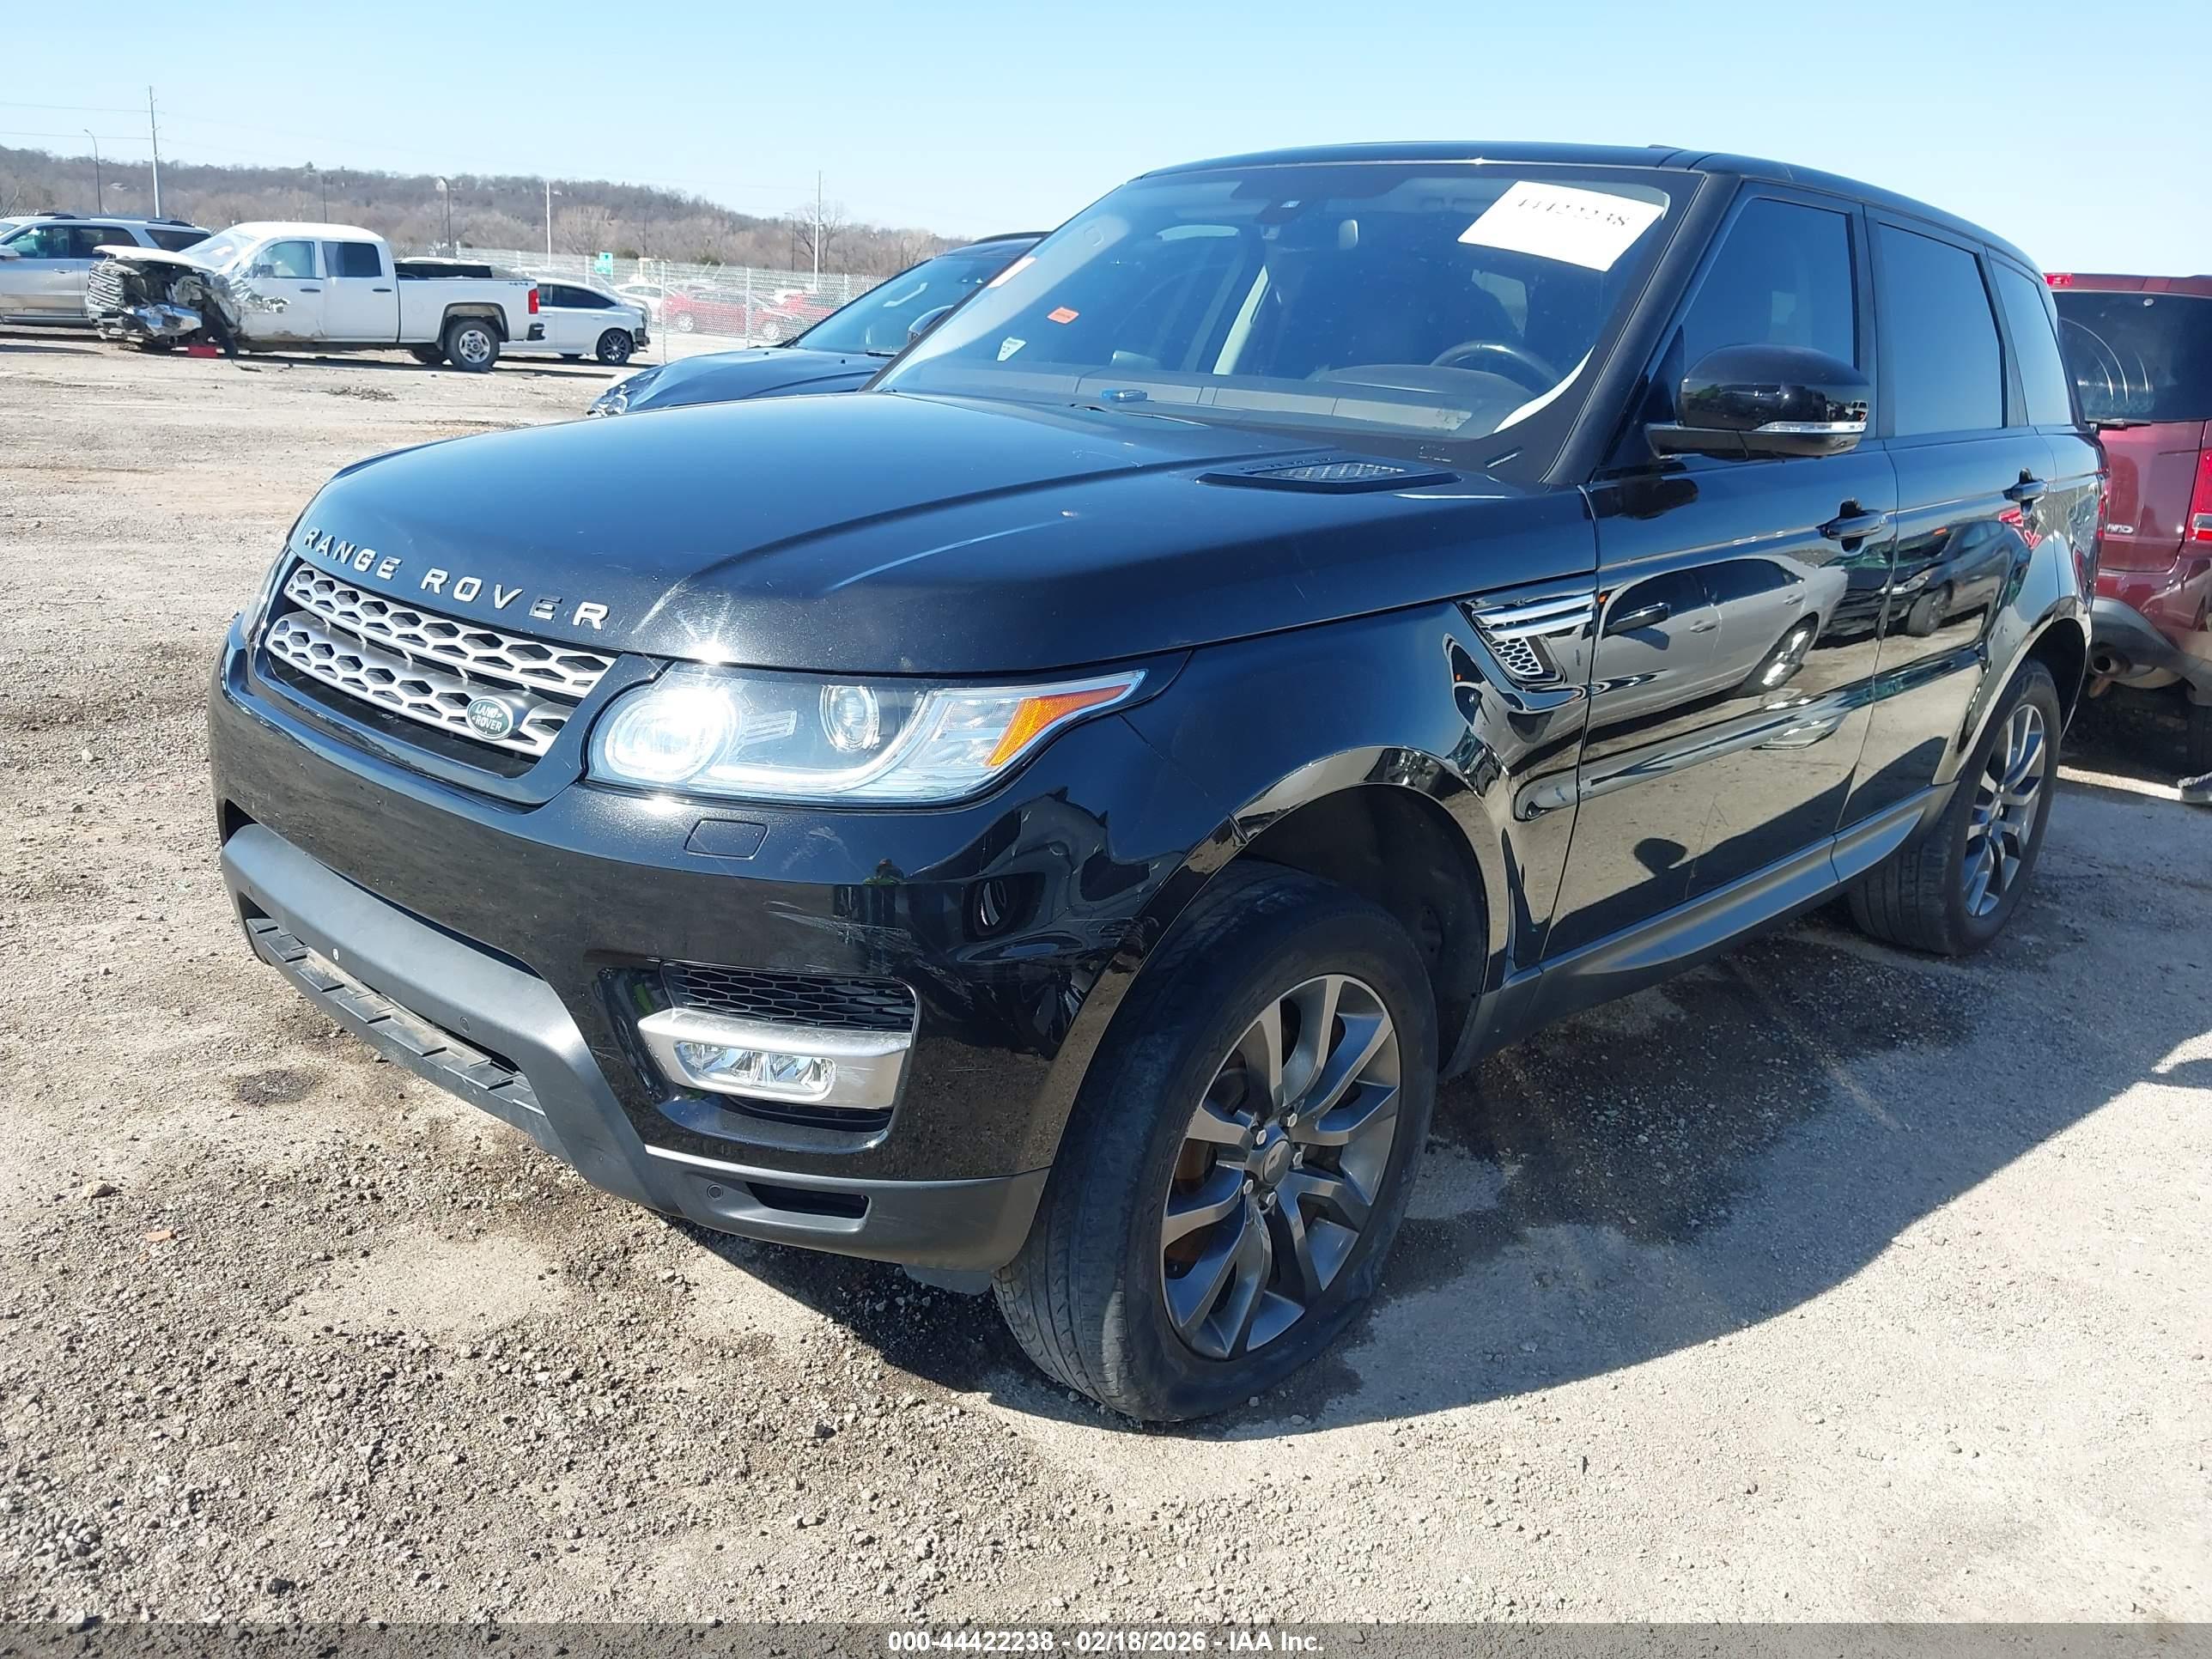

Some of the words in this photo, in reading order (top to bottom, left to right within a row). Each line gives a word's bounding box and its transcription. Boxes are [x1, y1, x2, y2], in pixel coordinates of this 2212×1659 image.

[304, 526, 403, 580] RANGE
[420, 568, 610, 630] ROVER
[474, 703, 499, 719] LAND
[475, 714, 503, 732] ROVER
